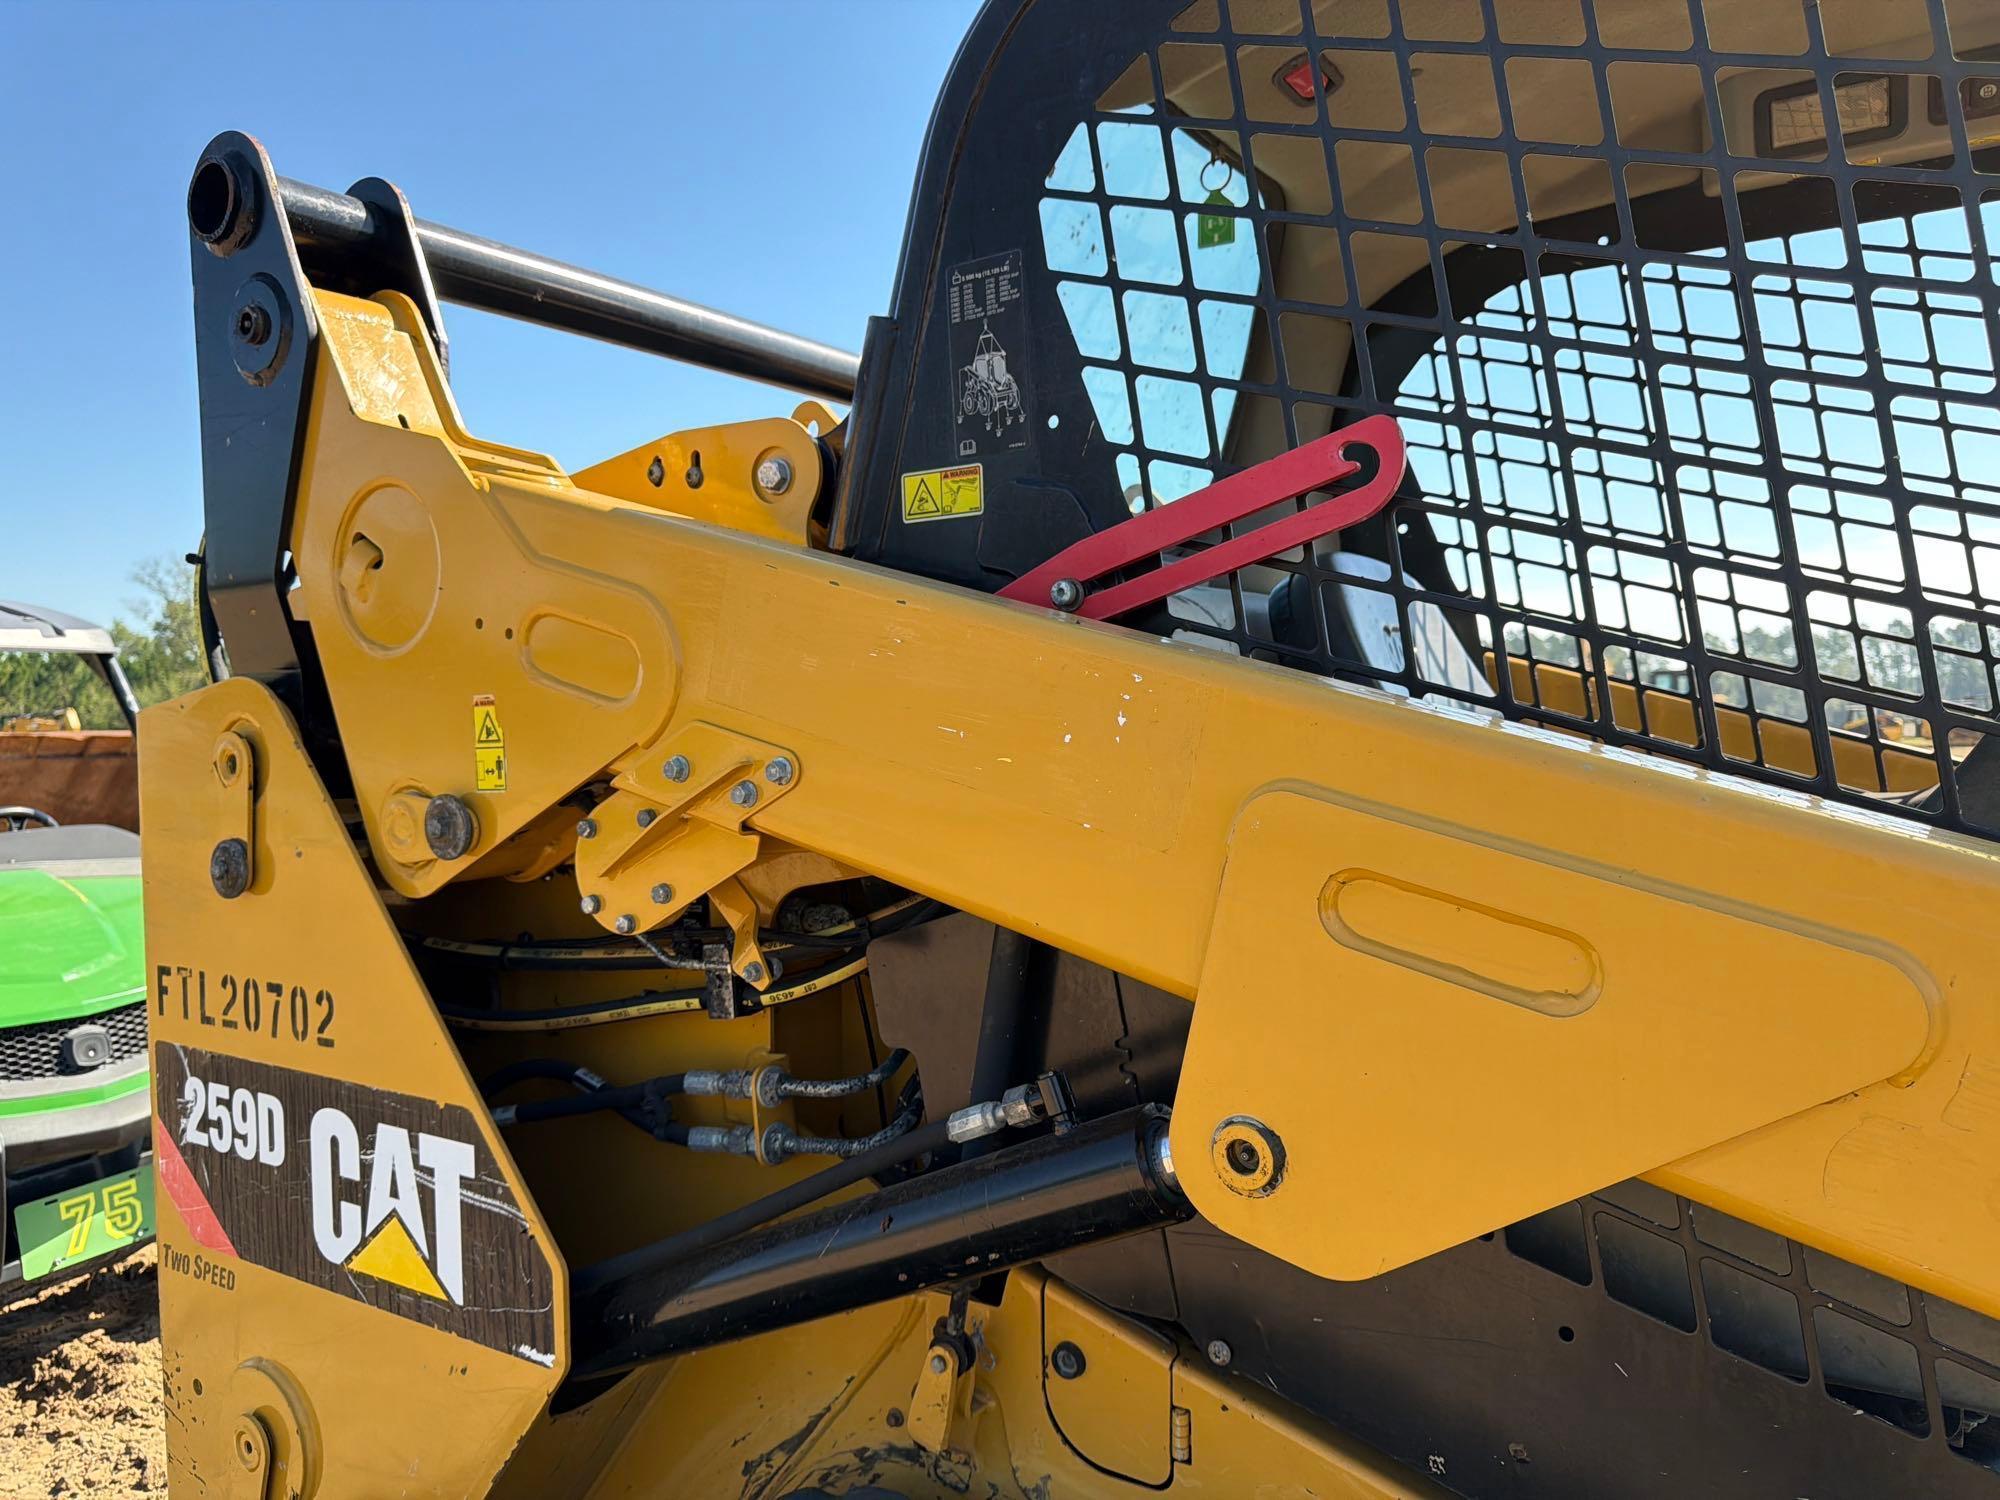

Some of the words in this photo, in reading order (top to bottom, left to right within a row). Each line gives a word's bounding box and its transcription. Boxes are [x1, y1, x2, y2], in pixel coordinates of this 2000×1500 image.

[157, 965, 335, 1048] FTL20702
[769, 991, 795, 1003] 4636
[183, 1076, 286, 1167] 259D
[59, 1178, 144, 1258] 75
[310, 1107, 476, 1307] CAT
[163, 1243, 190, 1276] TWO
[193, 1254, 236, 1292] SPEED
